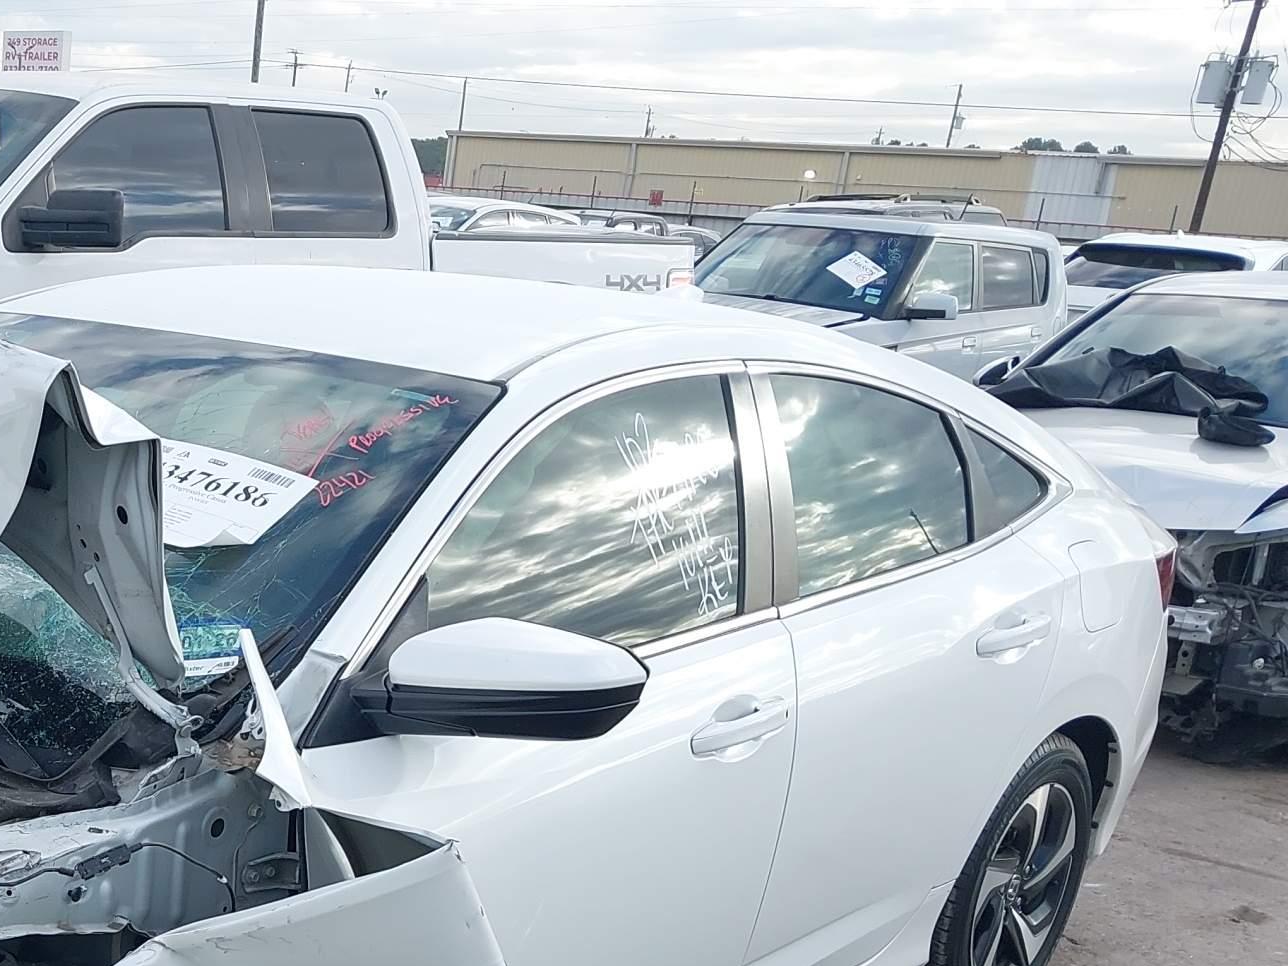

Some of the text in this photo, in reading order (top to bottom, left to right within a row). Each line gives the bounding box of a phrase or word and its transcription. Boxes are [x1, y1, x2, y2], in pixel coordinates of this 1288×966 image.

[22, 37, 58, 46] STORAGE
[23, 51, 59, 61] TRAILER
[162, 461, 278, 508] 3476186
